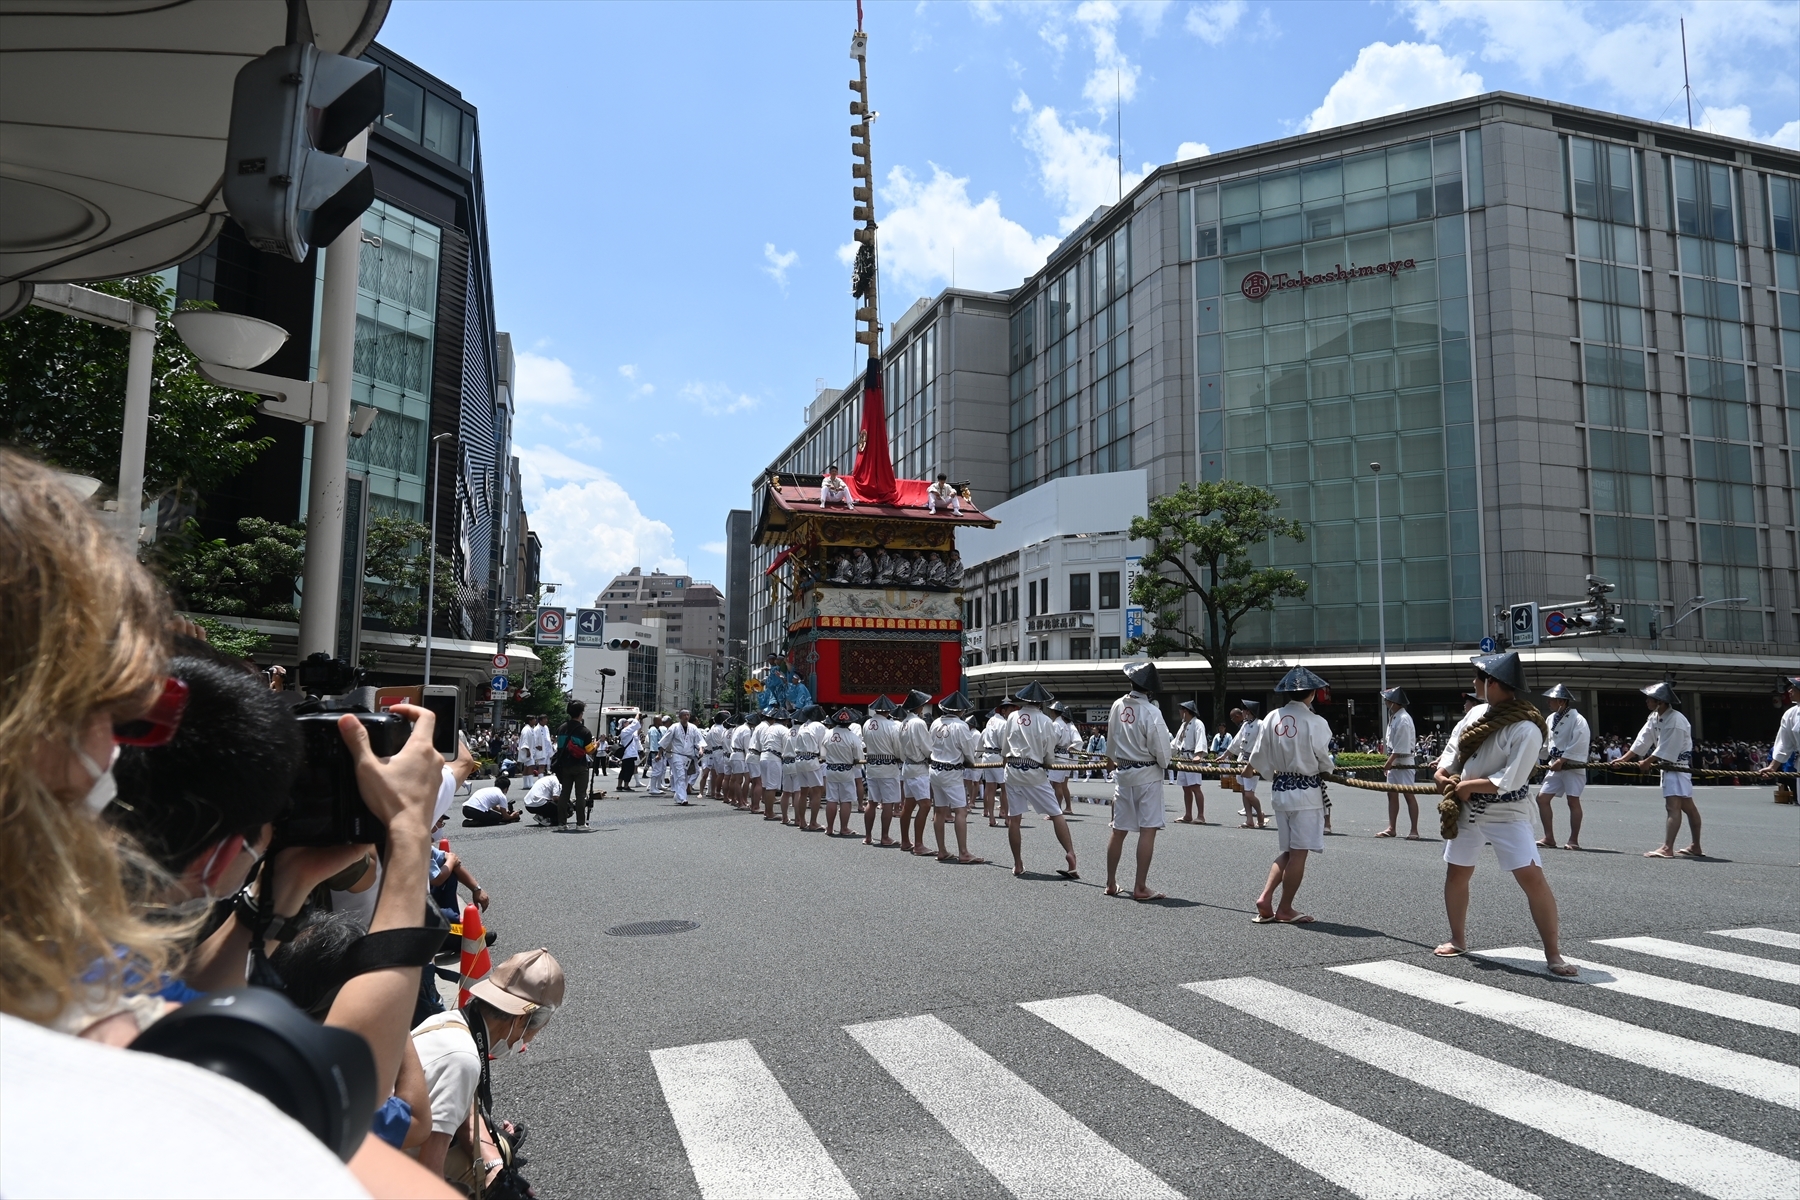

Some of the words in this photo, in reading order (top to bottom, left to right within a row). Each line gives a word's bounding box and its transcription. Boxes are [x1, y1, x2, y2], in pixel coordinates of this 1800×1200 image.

[1272, 258, 1416, 290] Takashimaya
[1127, 611, 1135, 638] 買えます
[476, 1032, 485, 1049] EOS
